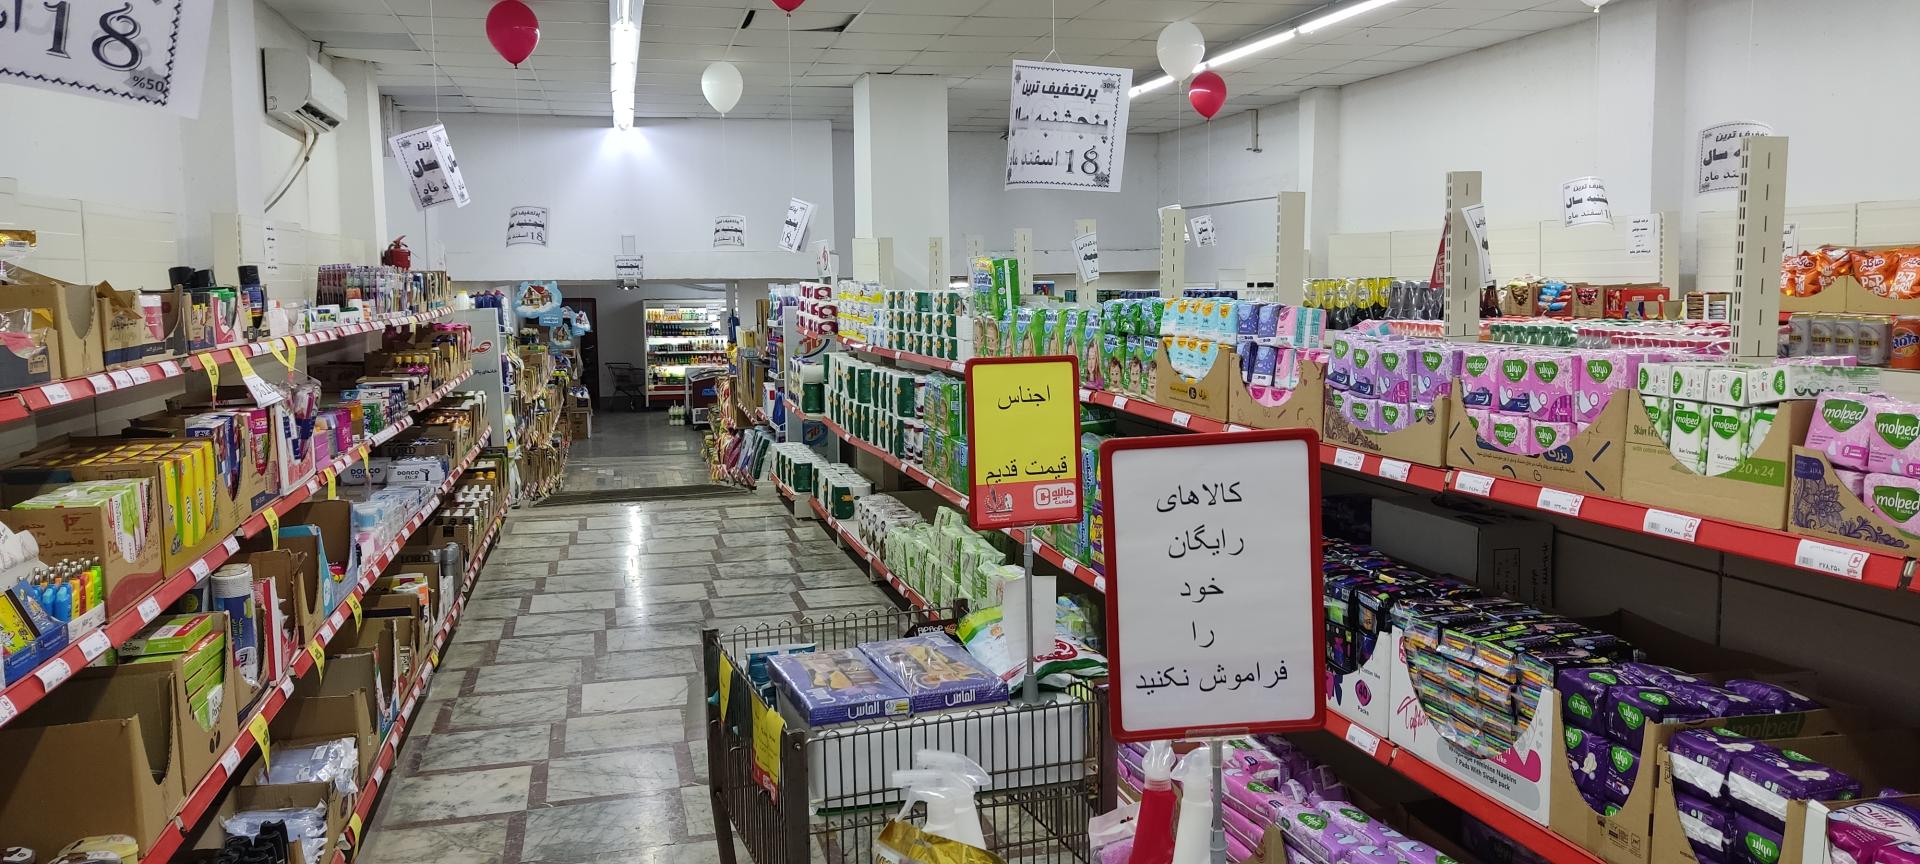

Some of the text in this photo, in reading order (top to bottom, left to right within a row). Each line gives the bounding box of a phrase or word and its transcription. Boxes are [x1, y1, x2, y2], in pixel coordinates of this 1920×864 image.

[44, 0, 143, 71] 18
[1021, 150, 1059, 166] اسفند
[1065, 145, 1099, 175] 18
[1703, 148, 1728, 166] سال
[1704, 171, 1720, 182] ماه
[531, 231, 543, 241] 18
[1892, 333, 1920, 349] anta
[998, 384, 1051, 410] اجناس
[1675, 414, 1699, 427] molped
[1823, 403, 1866, 422] molped
[1713, 418, 1739, 432] molped
[1878, 418, 1920, 439] molped
[985, 455, 1068, 488] قیمت قدیم
[1739, 463, 1753, 475] 20
[1761, 465, 1775, 478] 24
[1156, 481, 1243, 512] کالاهای
[1876, 491, 1920, 512] molped
[1168, 524, 1244, 559] رایگان
[1180, 577, 1224, 603] خود
[1192, 620, 1215, 648] را
[1135, 659, 1289, 695] فراموش نکنید
[945, 689, 976, 707] الماس
[847, 701, 880, 719] الماس
[1459, 759, 1470, 770] Pads
[1470, 764, 1482, 776] With
[1482, 769, 1498, 785] Single
[1498, 780, 1511, 791] pack
[1496, 766, 1517, 785] Napkins
